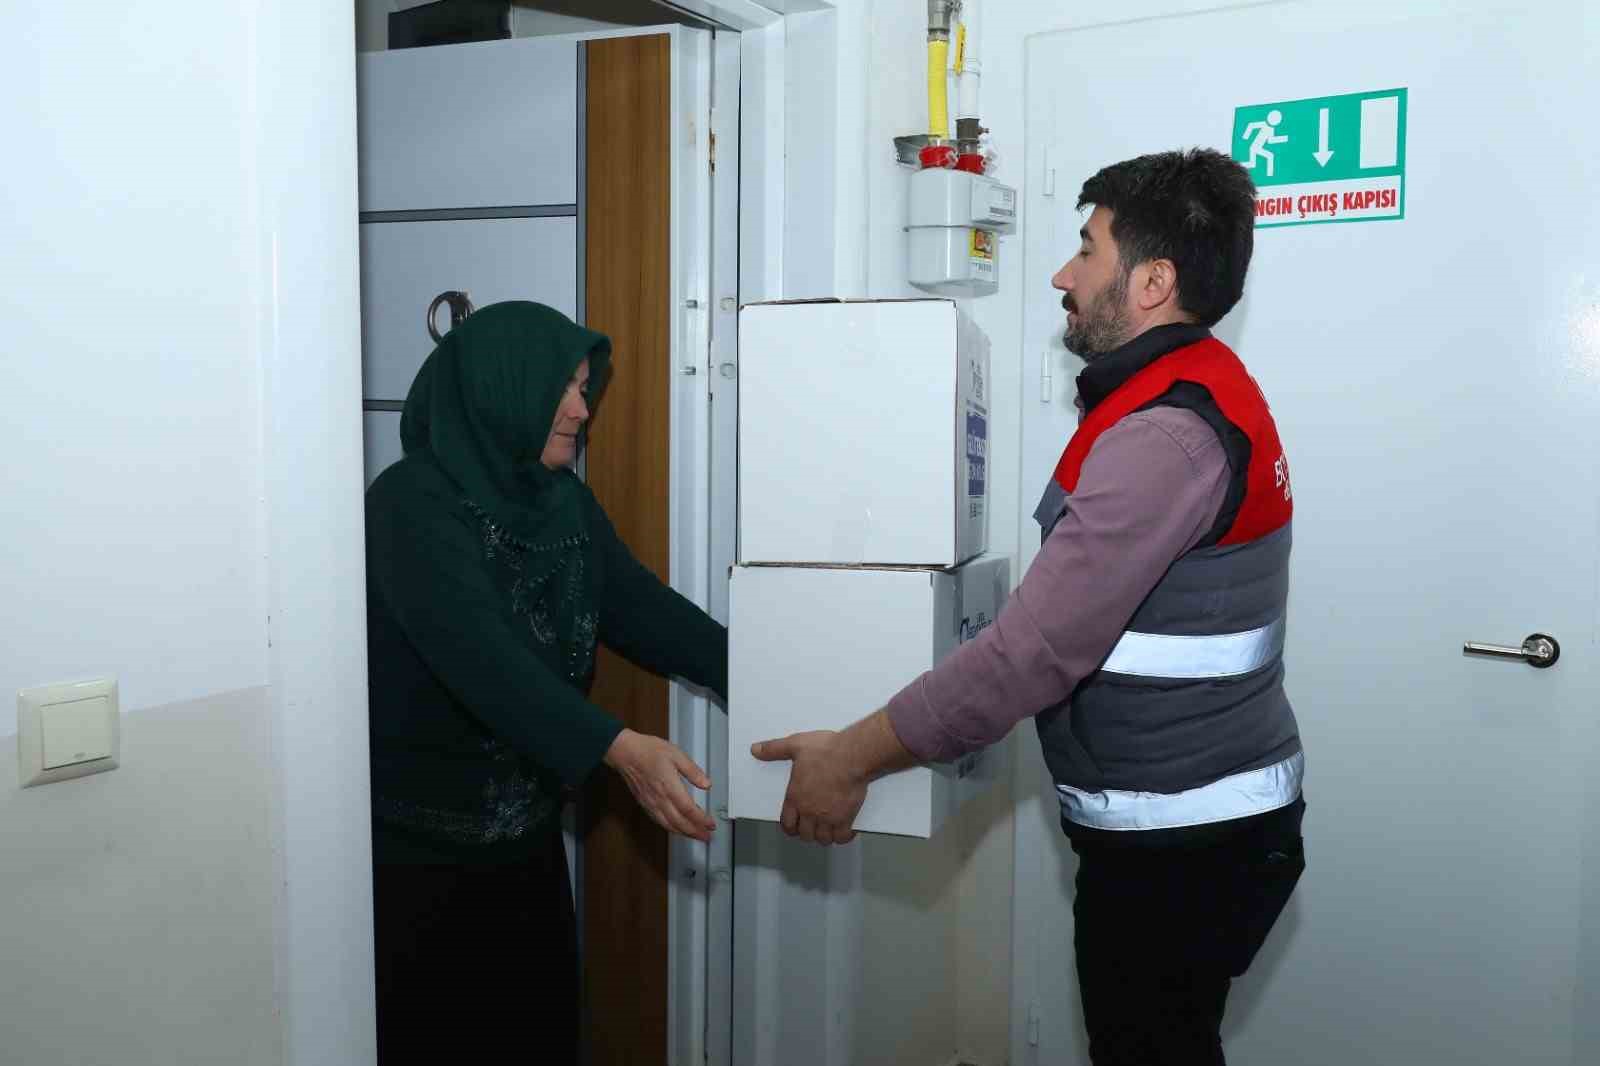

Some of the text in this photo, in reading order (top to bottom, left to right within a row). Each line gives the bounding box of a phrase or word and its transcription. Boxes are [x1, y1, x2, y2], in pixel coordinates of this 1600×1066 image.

[1254, 189, 1396, 218] NGIN ÇIKIŞ KAPISI
